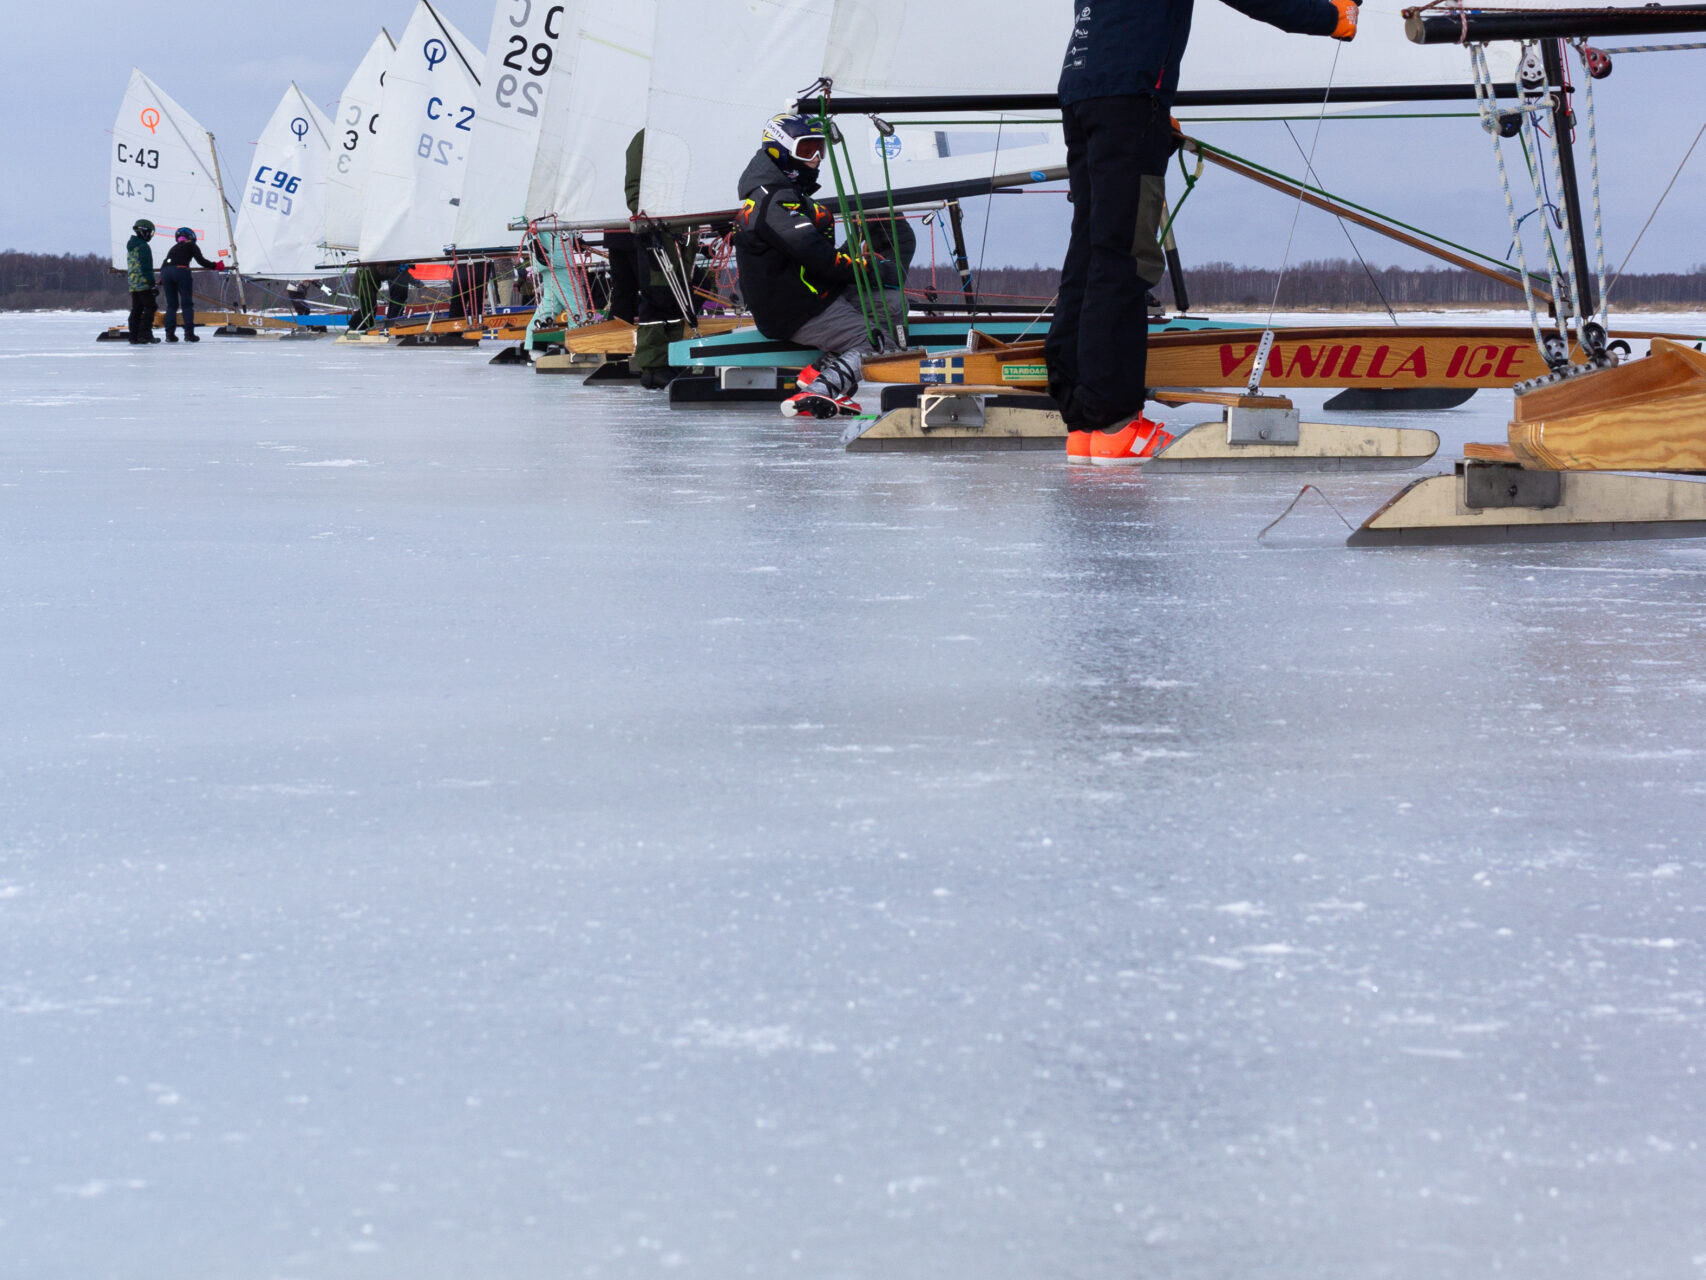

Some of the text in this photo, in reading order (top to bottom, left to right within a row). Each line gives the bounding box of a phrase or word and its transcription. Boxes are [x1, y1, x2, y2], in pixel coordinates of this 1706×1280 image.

[544, 6, 564, 39] C
[503, 35, 553, 76] 29
[117, 143, 159, 169] C-43
[343, 130, 358, 150] 3
[1219, 344, 1530, 378] VANILLA ICE
